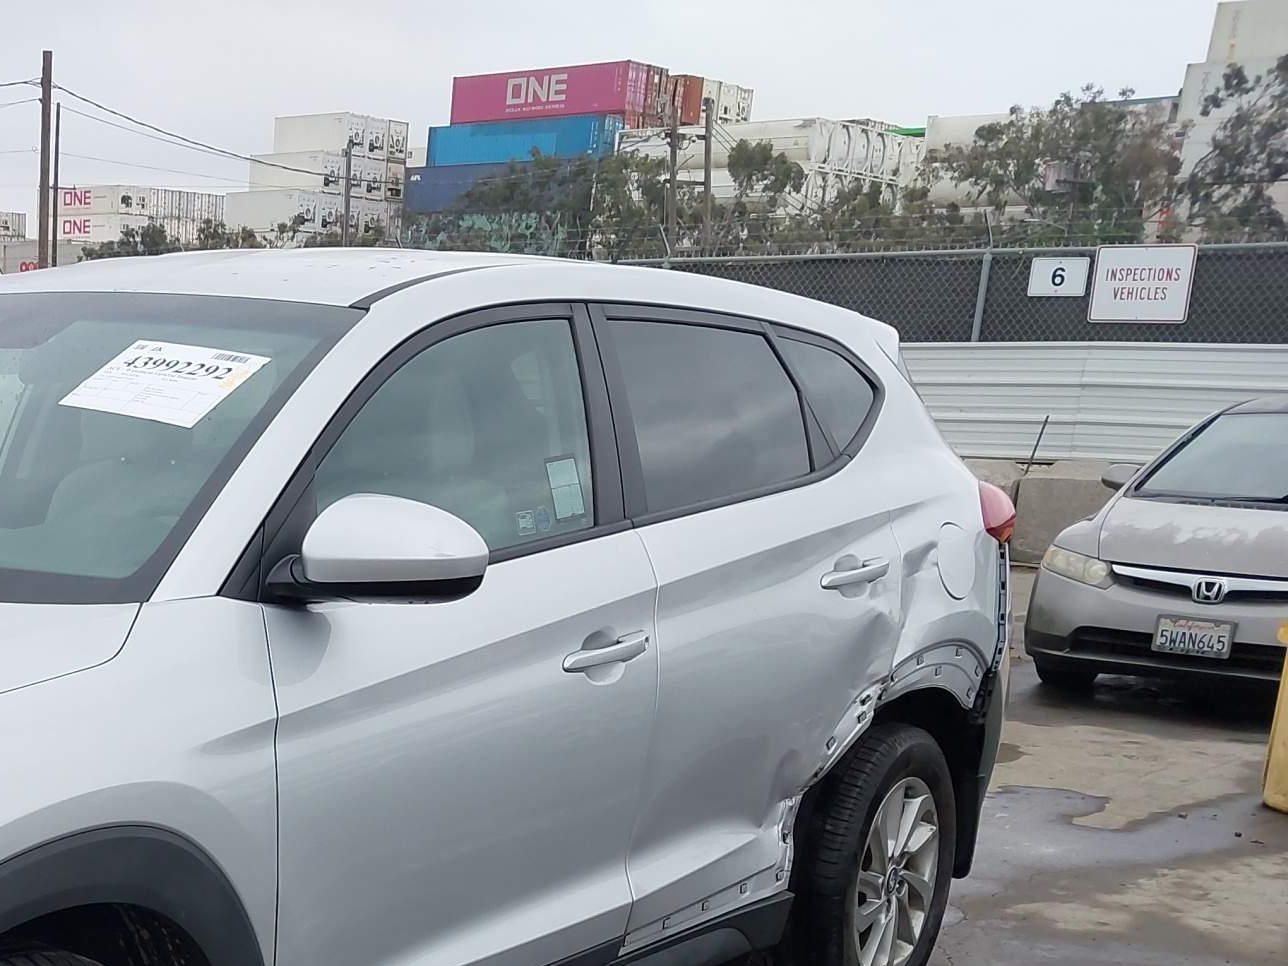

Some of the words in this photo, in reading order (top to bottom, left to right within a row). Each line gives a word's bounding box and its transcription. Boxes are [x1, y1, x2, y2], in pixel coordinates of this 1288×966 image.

[506, 74, 568, 105] ONE
[63, 190, 92, 207] ONE
[62, 219, 91, 235] ONE
[1051, 267, 1065, 287] 6
[1106, 267, 1181, 282] INSPECTIONS
[1113, 287, 1168, 301] VEHICLES
[123, 355, 233, 380] 43992292
[1159, 629, 1226, 652] 5WAN645
